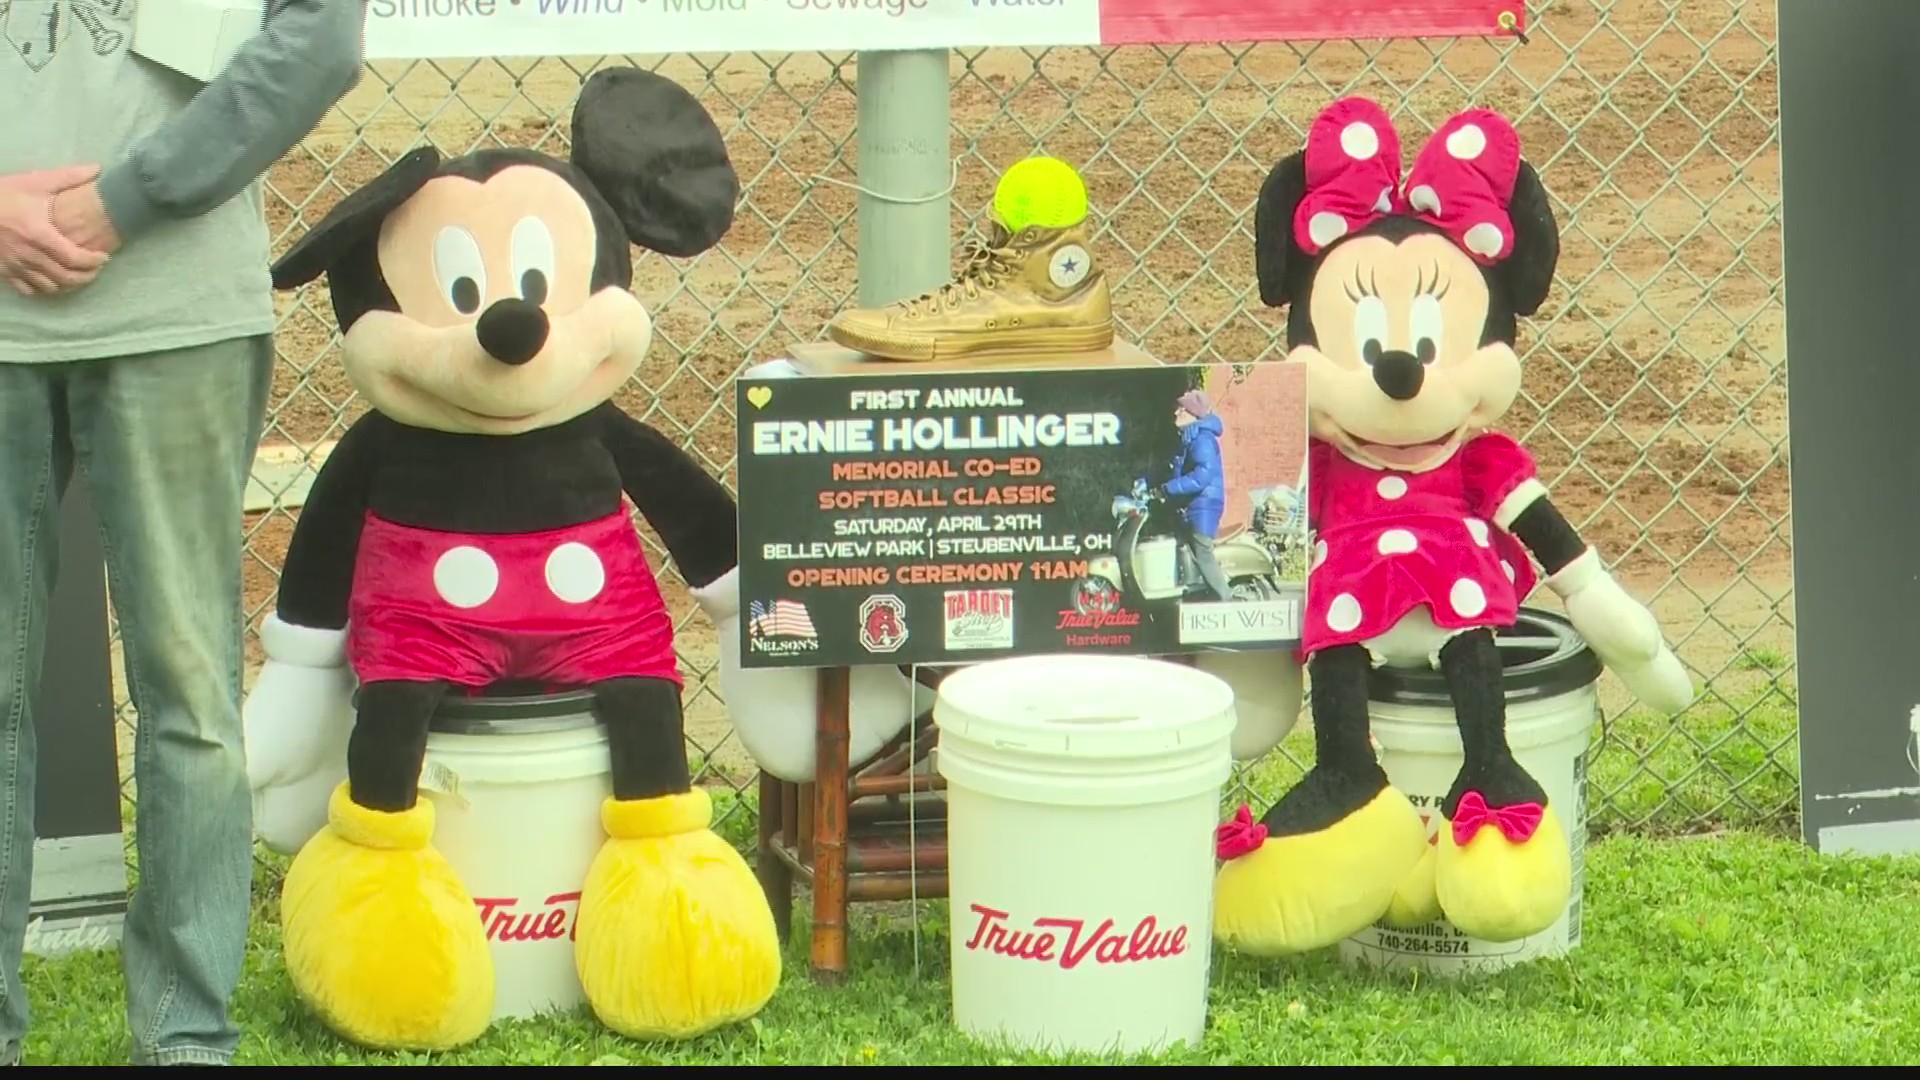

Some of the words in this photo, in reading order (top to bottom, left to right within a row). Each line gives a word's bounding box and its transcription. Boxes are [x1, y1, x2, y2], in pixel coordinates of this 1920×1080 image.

[850, 389, 921, 410] FIRST
[926, 387, 1023, 410] ANNUAL
[753, 419, 874, 455] ERNIE
[882, 413, 1121, 451] HOLLINGER
[832, 460, 958, 481] MEMORIAL
[964, 457, 1042, 477] CO-ED
[818, 489, 948, 510] SOFTBALL
[953, 486, 1056, 505] CLASSIC
[834, 517, 933, 537] SATURDAY,
[937, 515, 990, 532] APRIL
[994, 514, 1043, 531] 29TH
[763, 541, 873, 560] BELLEVIEW
[875, 539, 926, 557] PARK
[937, 535, 1081, 555] STEUBENVILLE,
[1087, 533, 1113, 551] OH
[787, 568, 890, 588] OPENING
[895, 562, 1023, 584] CEREMONY
[1029, 559, 1089, 580] 11AM
[1066, 633, 1132, 646] Hardware
[1377, 932, 1470, 954] 740-264-5574
